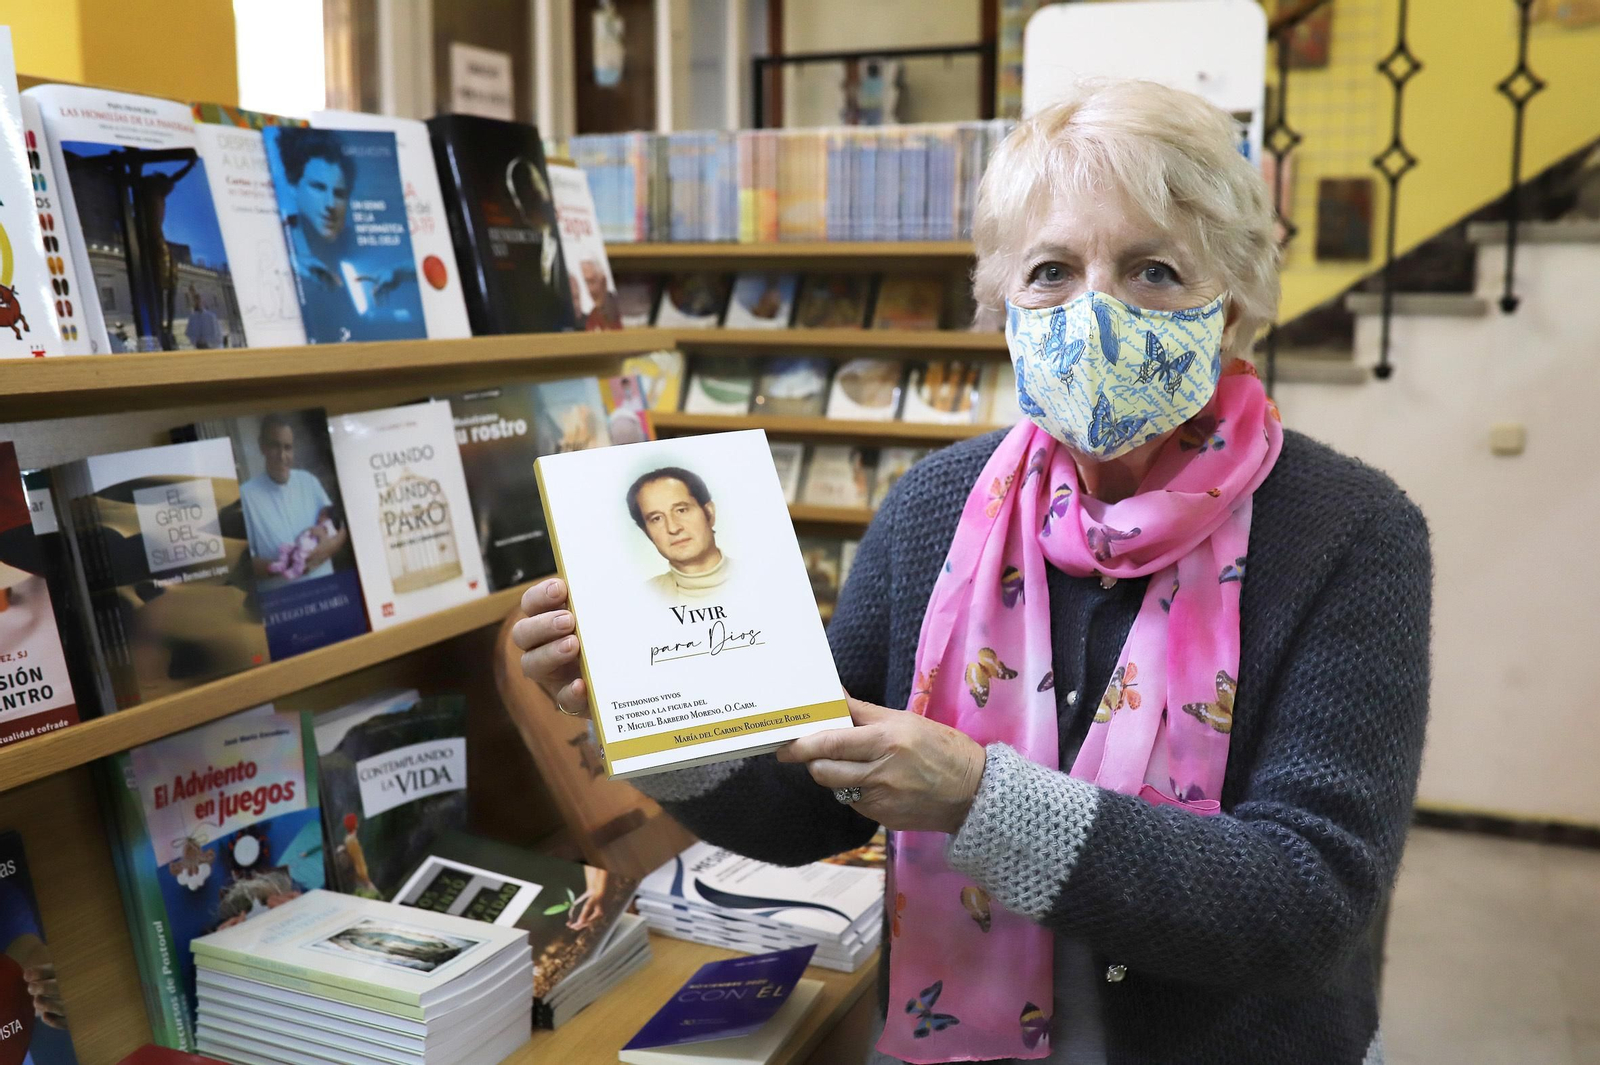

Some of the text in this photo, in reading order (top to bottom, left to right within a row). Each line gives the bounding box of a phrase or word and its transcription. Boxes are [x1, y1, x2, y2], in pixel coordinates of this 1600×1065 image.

[471, 418, 528, 443] rostro
[369, 444, 435, 470] CUANDO
[374, 471, 390, 489] EL
[166, 489, 184, 505] EL
[379, 479, 441, 506] MUNDO
[156, 504, 202, 526] GRITO
[168, 525, 199, 543] DEL
[152, 538, 220, 566] SILENCIO
[17, 650, 28, 659] SJ
[650, 620, 761, 666] para Dios
[611, 691, 681, 710] TESTIMONIOS VIVOS
[615, 714, 625, 722] EN
[625, 710, 650, 720] TORNO
[657, 706, 667, 714] LA
[668, 702, 693, 712] FIGURA
[693, 699, 708, 707] DEL
[37, 720, 69, 734] cofrade
[617, 724, 626, 733] P.
[627, 720, 657, 732] MIGUEL
[657, 714, 690, 726] BARBERO
[673, 732, 698, 744] MARÍA
[699, 731, 714, 740] DEL
[713, 725, 744, 737] CARMEN
[784, 712, 811, 723] ROBLES
[361, 747, 454, 781] CONTEMPLANDO
[154, 784, 169, 810] El
[172, 760, 257, 803] Adviento
[381, 764, 452, 795] LA VIDA
[195, 780, 296, 827] en juegos
[153, 920, 173, 976] Pastoral
[166, 977, 177, 994] de
[678, 988, 748, 1003] CON
